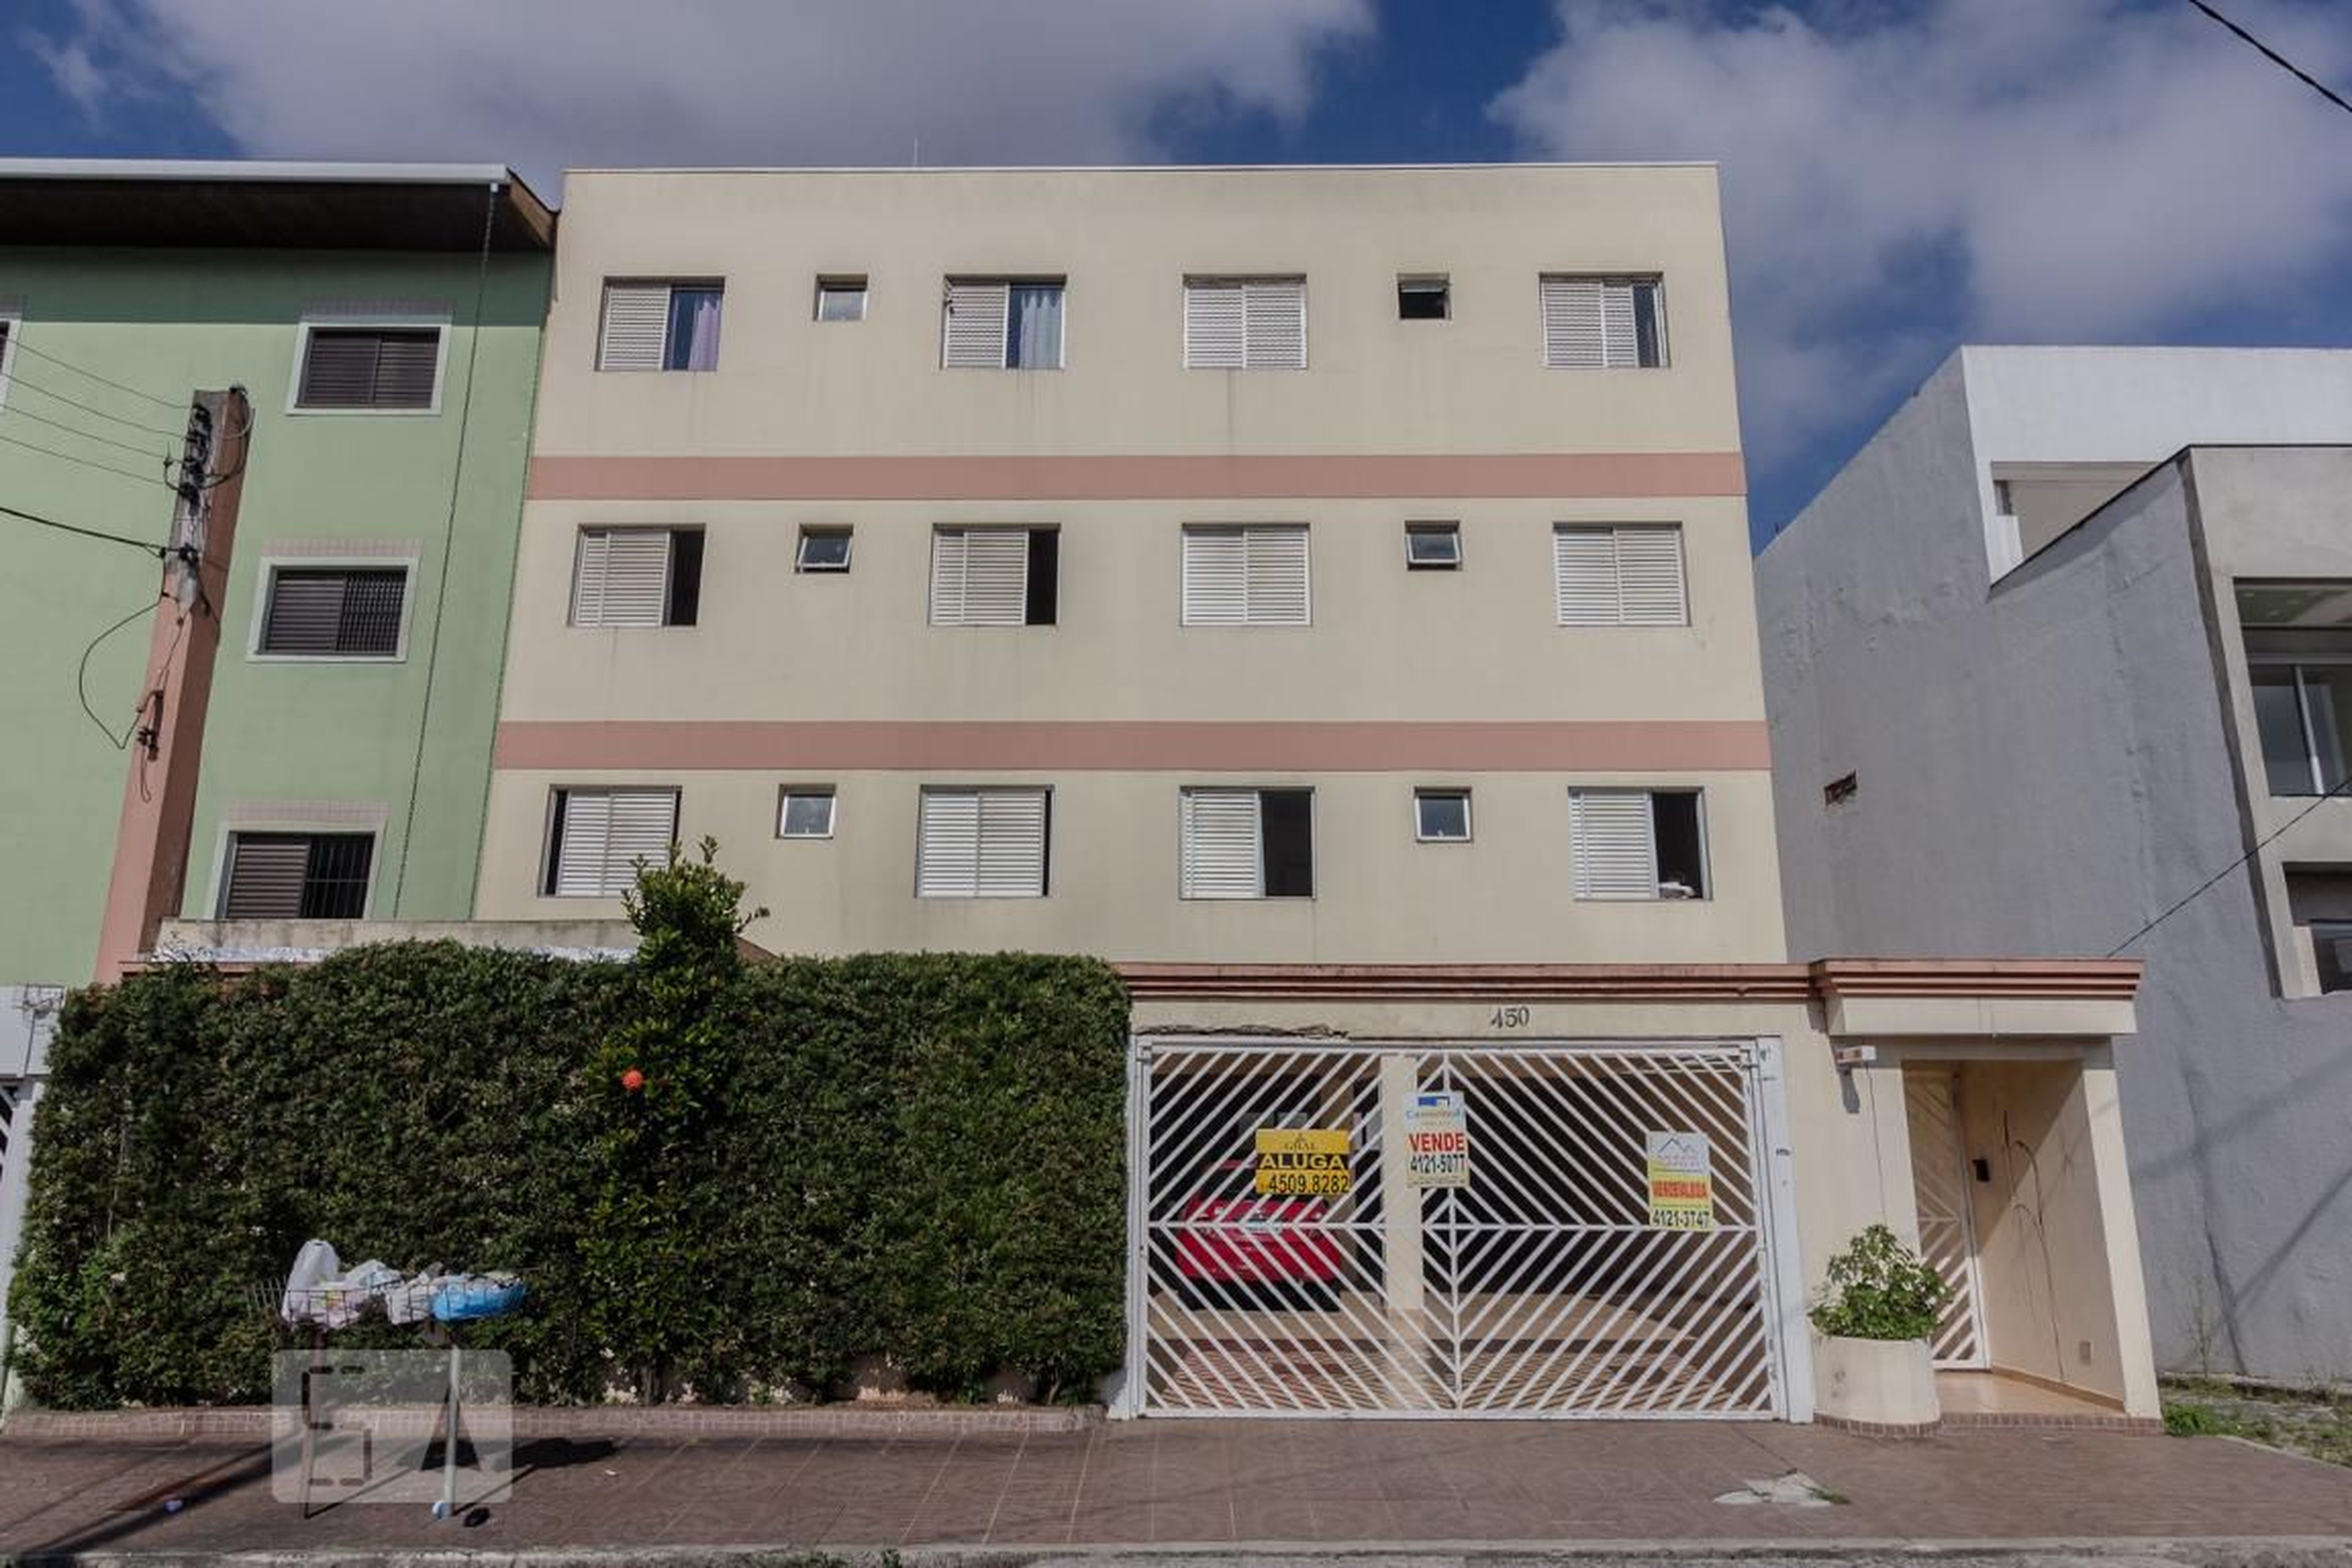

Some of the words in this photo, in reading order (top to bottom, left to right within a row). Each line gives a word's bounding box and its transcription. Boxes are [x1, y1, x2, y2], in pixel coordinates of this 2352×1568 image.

[1408, 1133, 1465, 1152] VENDE
[1259, 1154, 1345, 1169] ALUGA
[1268, 1173, 1349, 1194] 4509.8282
